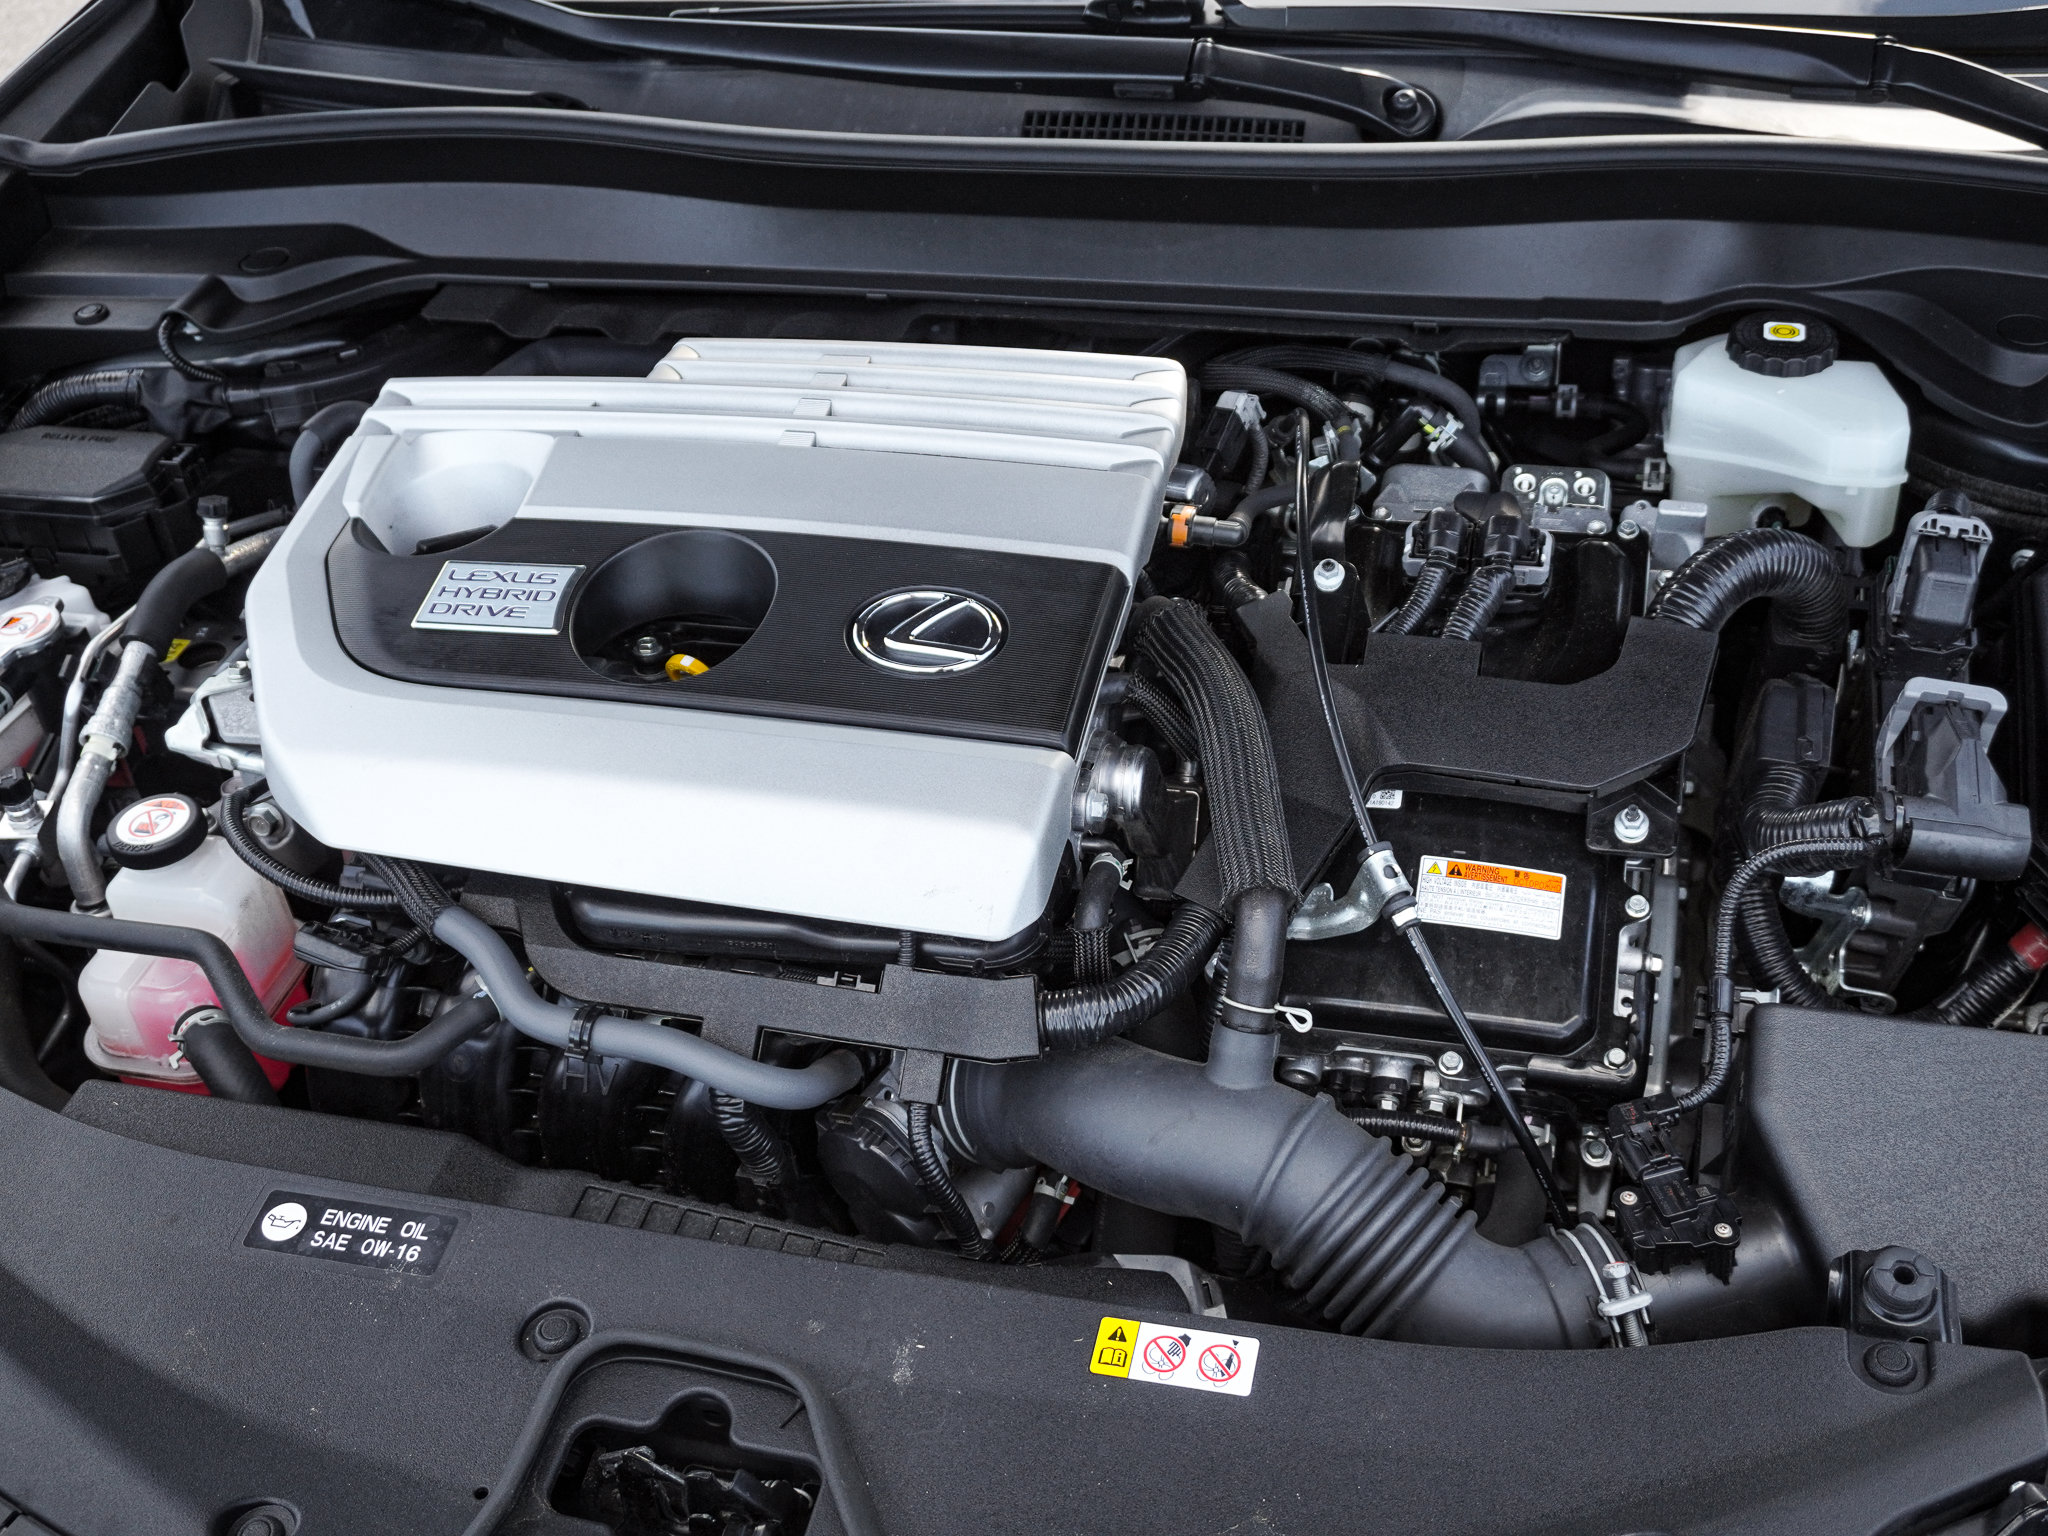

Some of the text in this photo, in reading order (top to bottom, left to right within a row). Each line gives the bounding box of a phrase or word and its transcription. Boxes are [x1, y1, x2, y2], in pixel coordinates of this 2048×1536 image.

[449, 569, 559, 585] LEXUS
[438, 586, 556, 602] HYBRID
[428, 603, 530, 619] DRIVE
[112, 841, 154, 852] DENSO
[1465, 863, 1500, 875] WARNING
[1464, 872, 1508, 883] AVERTISSEMENT
[320, 1208, 429, 1241] ENGINE OIL
[310, 1230, 422, 1262] SAE 0W-16
